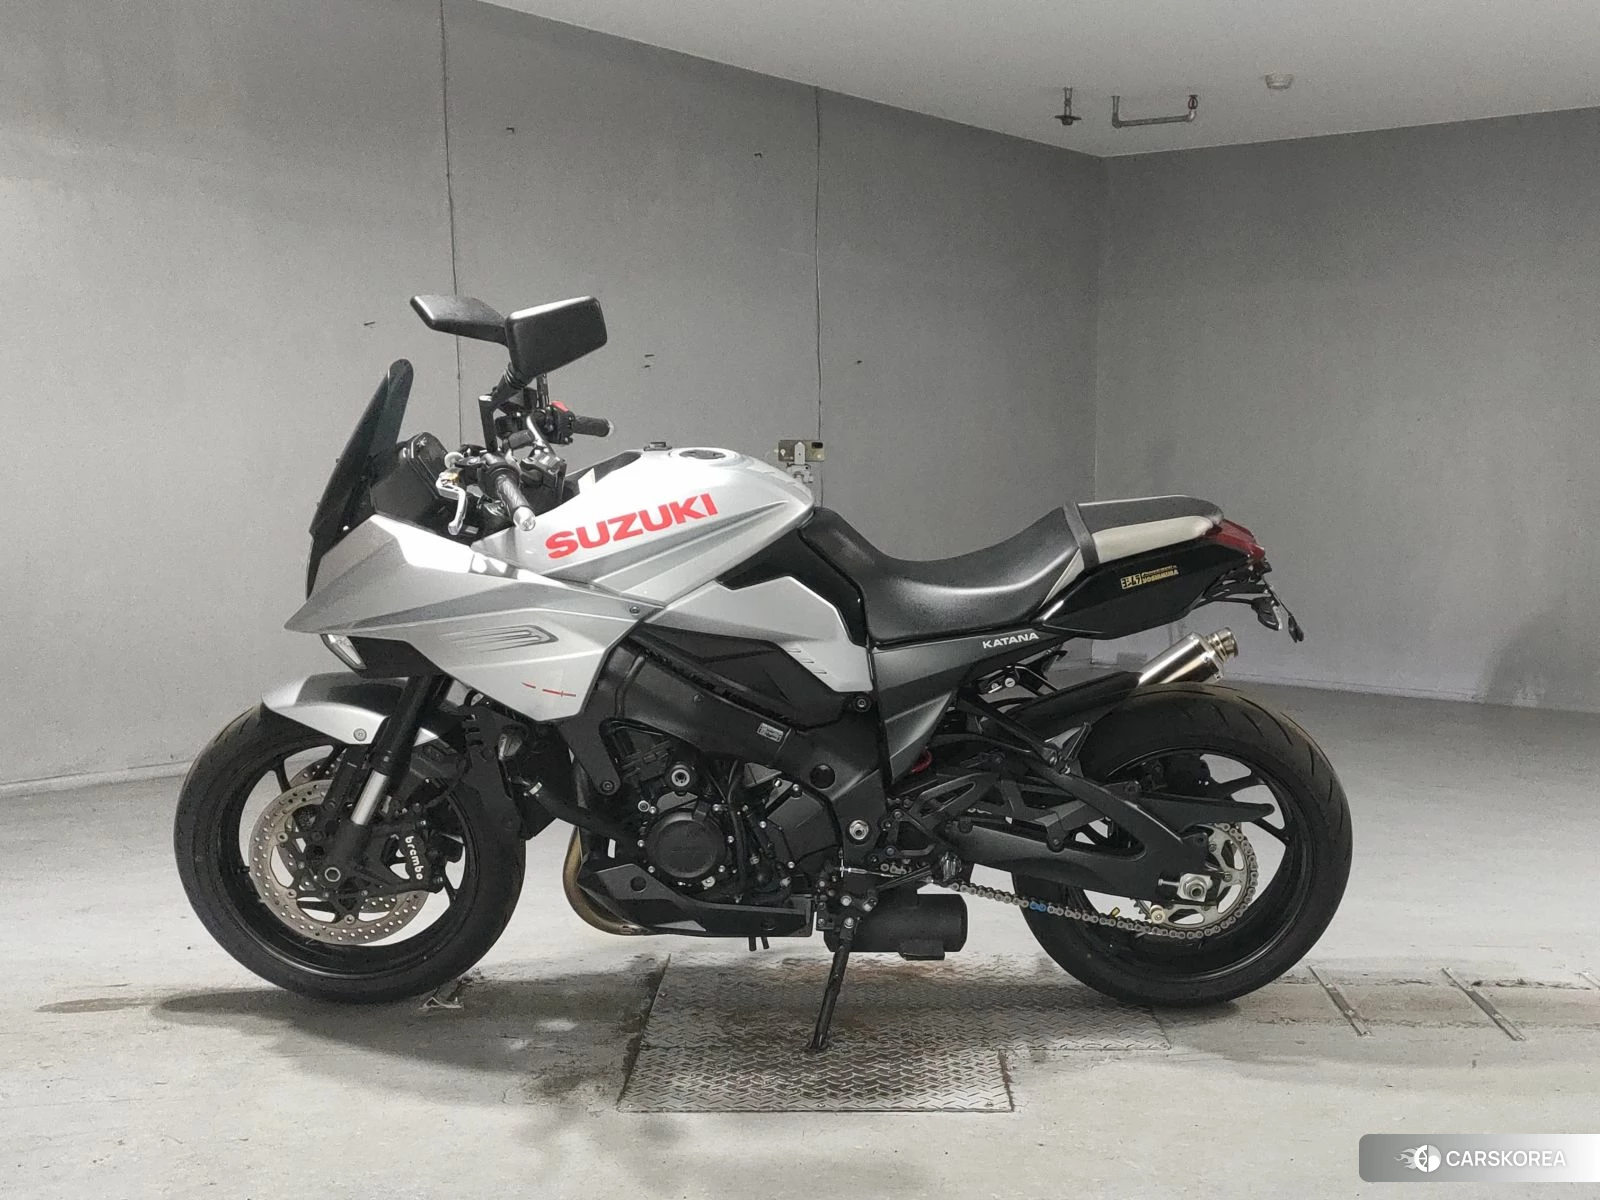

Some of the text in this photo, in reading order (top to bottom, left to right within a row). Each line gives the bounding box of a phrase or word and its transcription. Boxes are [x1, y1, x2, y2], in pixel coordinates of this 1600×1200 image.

[545, 493, 718, 559] SUZUKI
[982, 632, 1039, 649] KATANA
[405, 835, 424, 880] brembo
